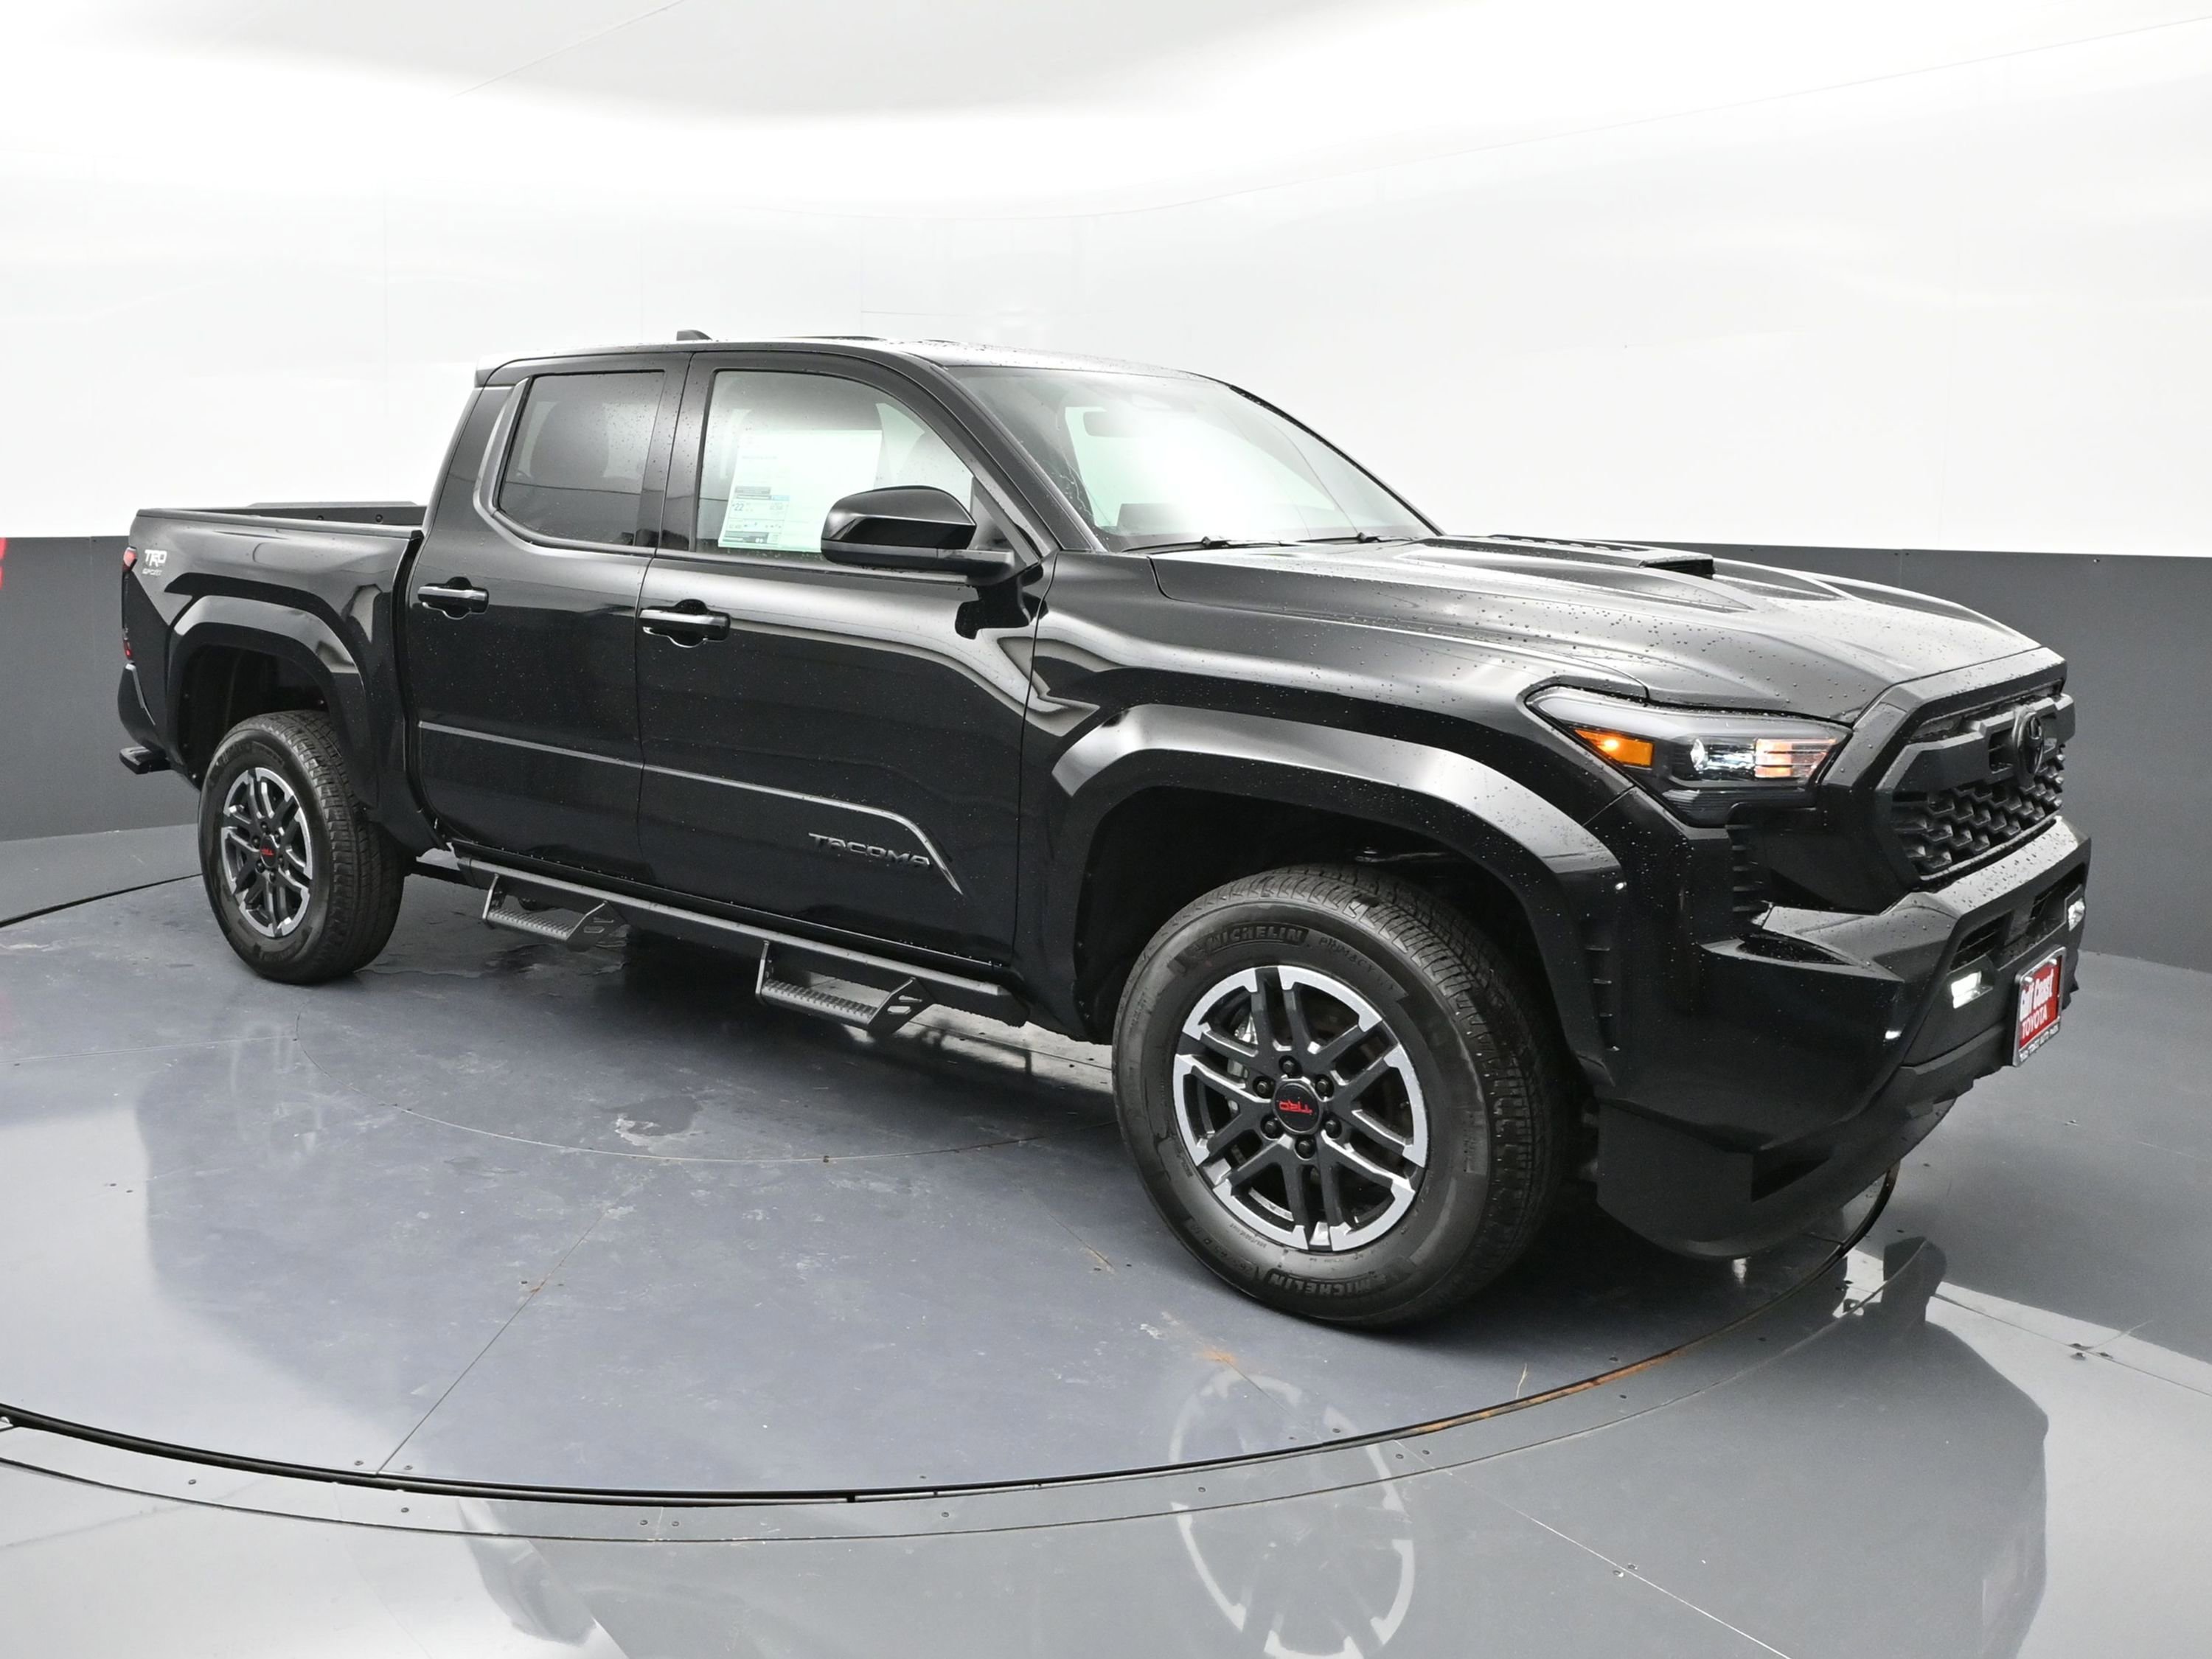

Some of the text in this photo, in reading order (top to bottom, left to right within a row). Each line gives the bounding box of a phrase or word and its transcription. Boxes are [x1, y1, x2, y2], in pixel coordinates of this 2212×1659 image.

[734, 502, 744, 511] 22
[145, 549, 167, 567] TRD
[142, 568, 162, 576] SPORT
[808, 833, 931, 868] TACOMA
[1206, 925, 1303, 950] MICHELIN
[2022, 1004, 2048, 1039] TOYOTA
[1279, 1100, 1313, 1115] TRD
[1267, 1272, 1371, 1296] MICHELIN
